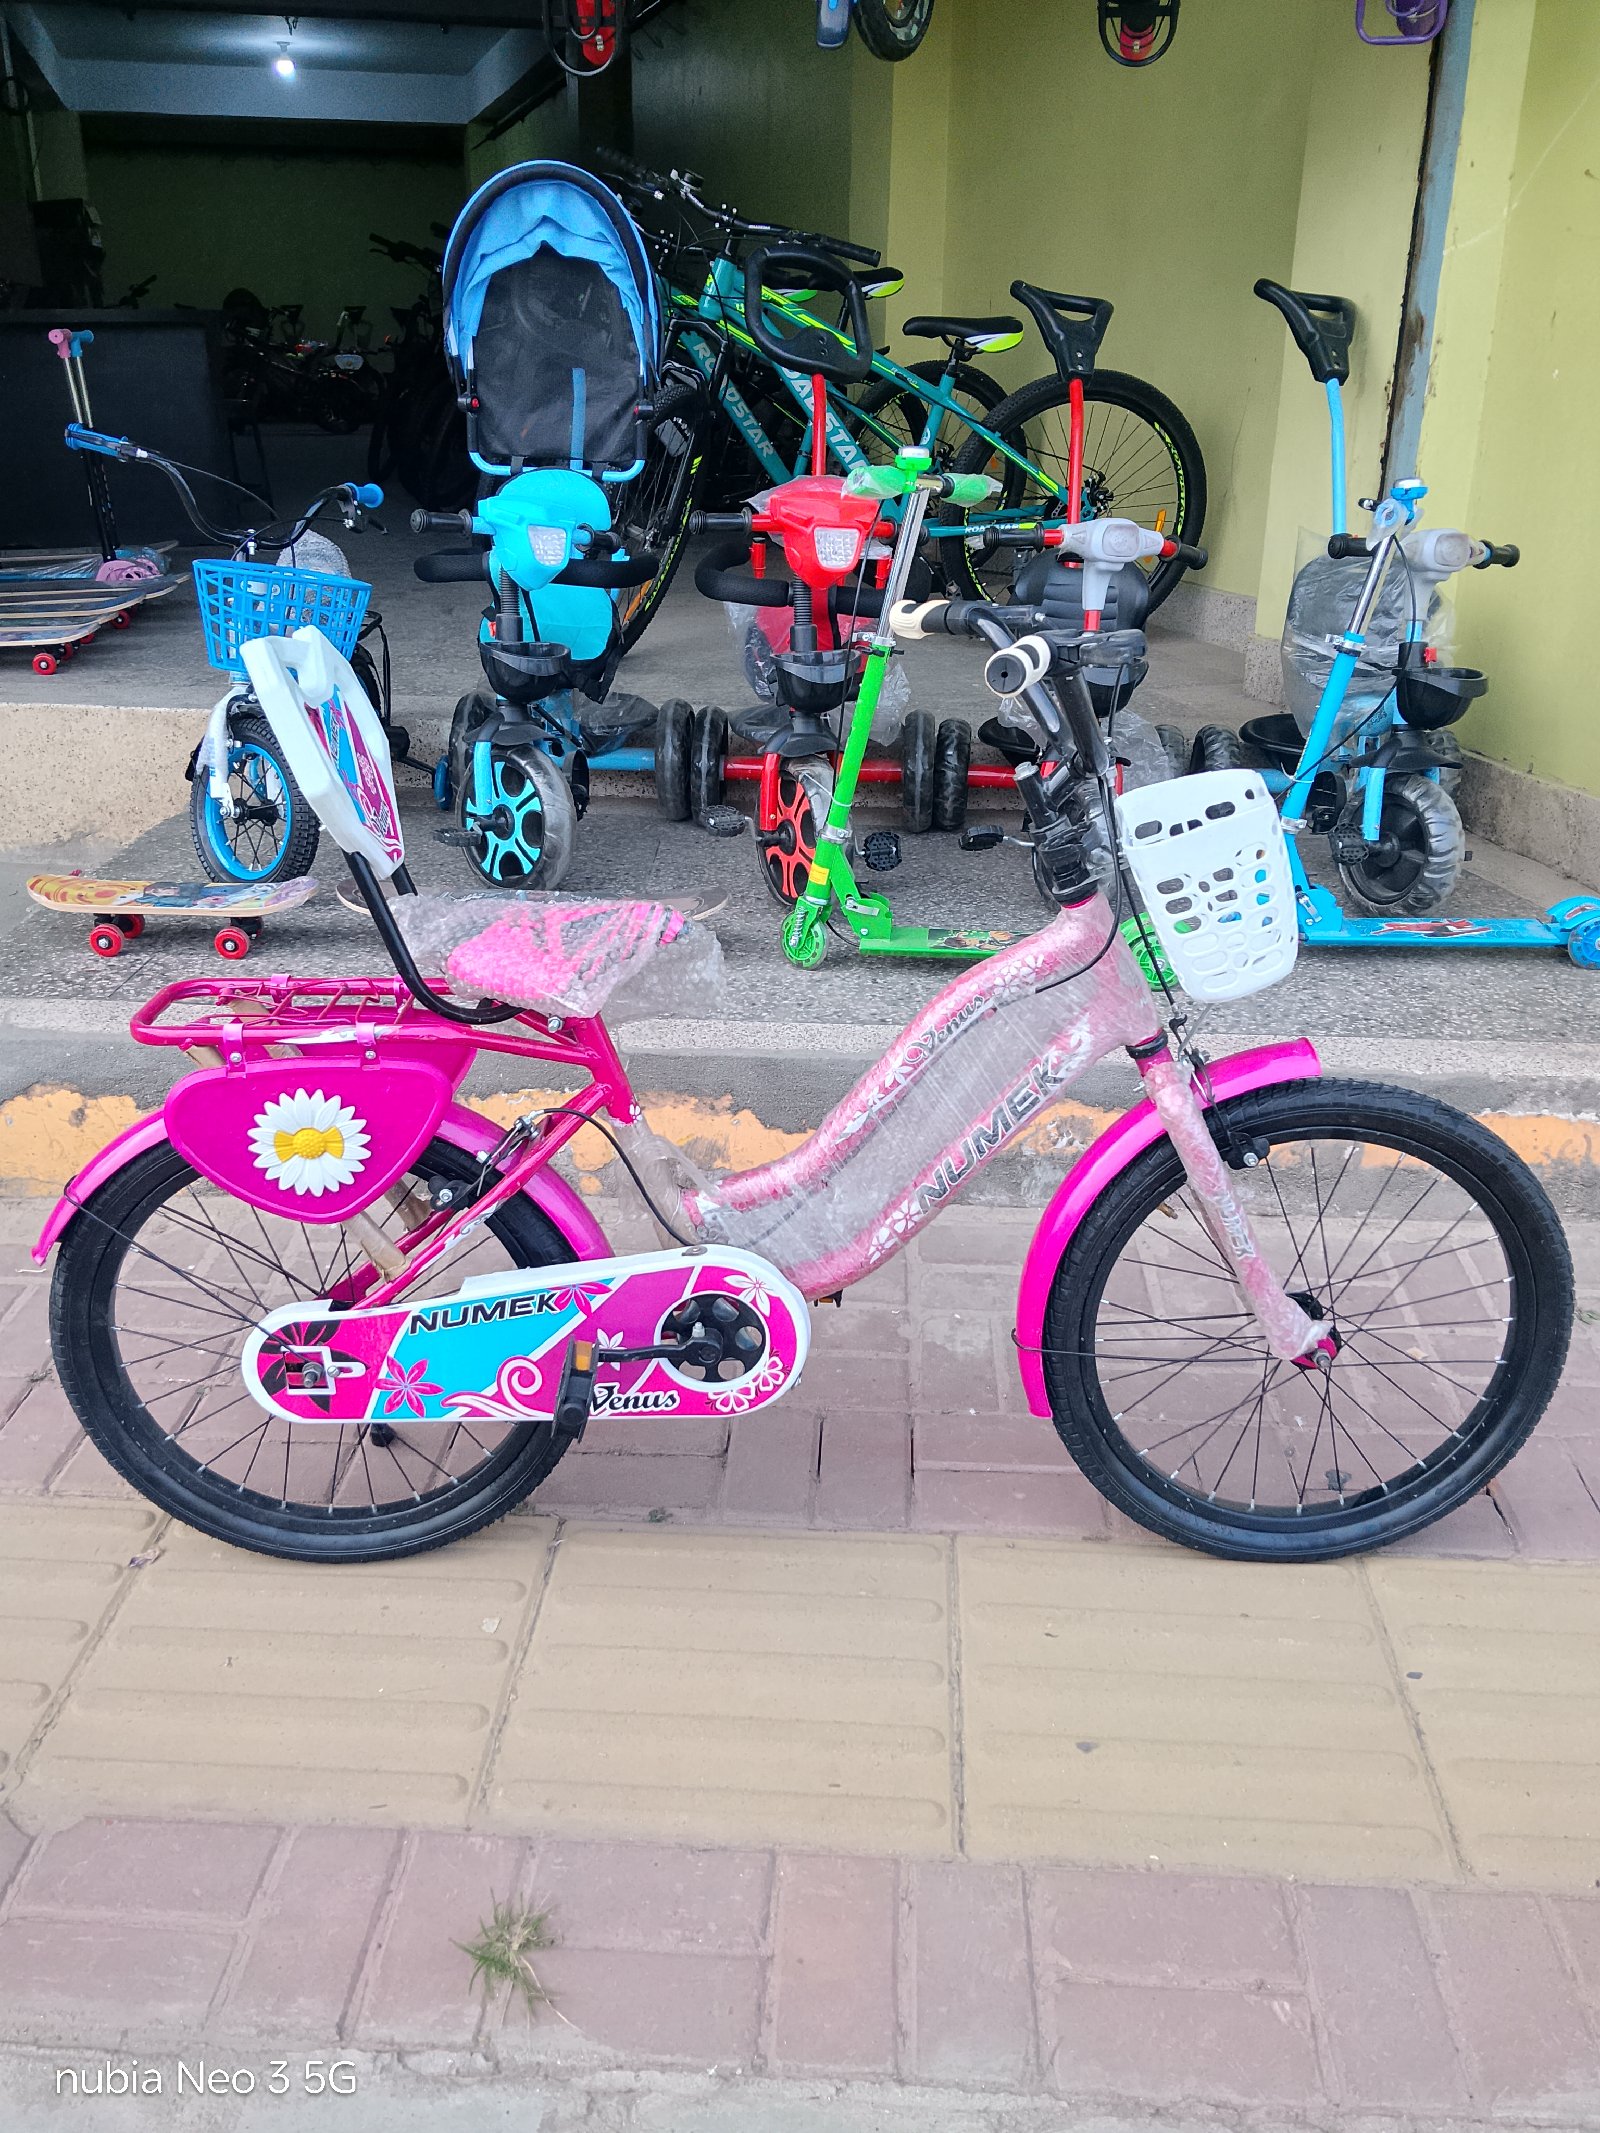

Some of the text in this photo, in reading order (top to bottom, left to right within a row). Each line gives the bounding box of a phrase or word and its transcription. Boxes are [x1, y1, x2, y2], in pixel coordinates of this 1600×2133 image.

[693, 342, 774, 458] RODSTAR
[903, 995, 984, 1064] Venus
[912, 1054, 1065, 1215] NUMEK
[408, 1290, 560, 1336] NUMEK
[590, 1382, 680, 1414] Venus
